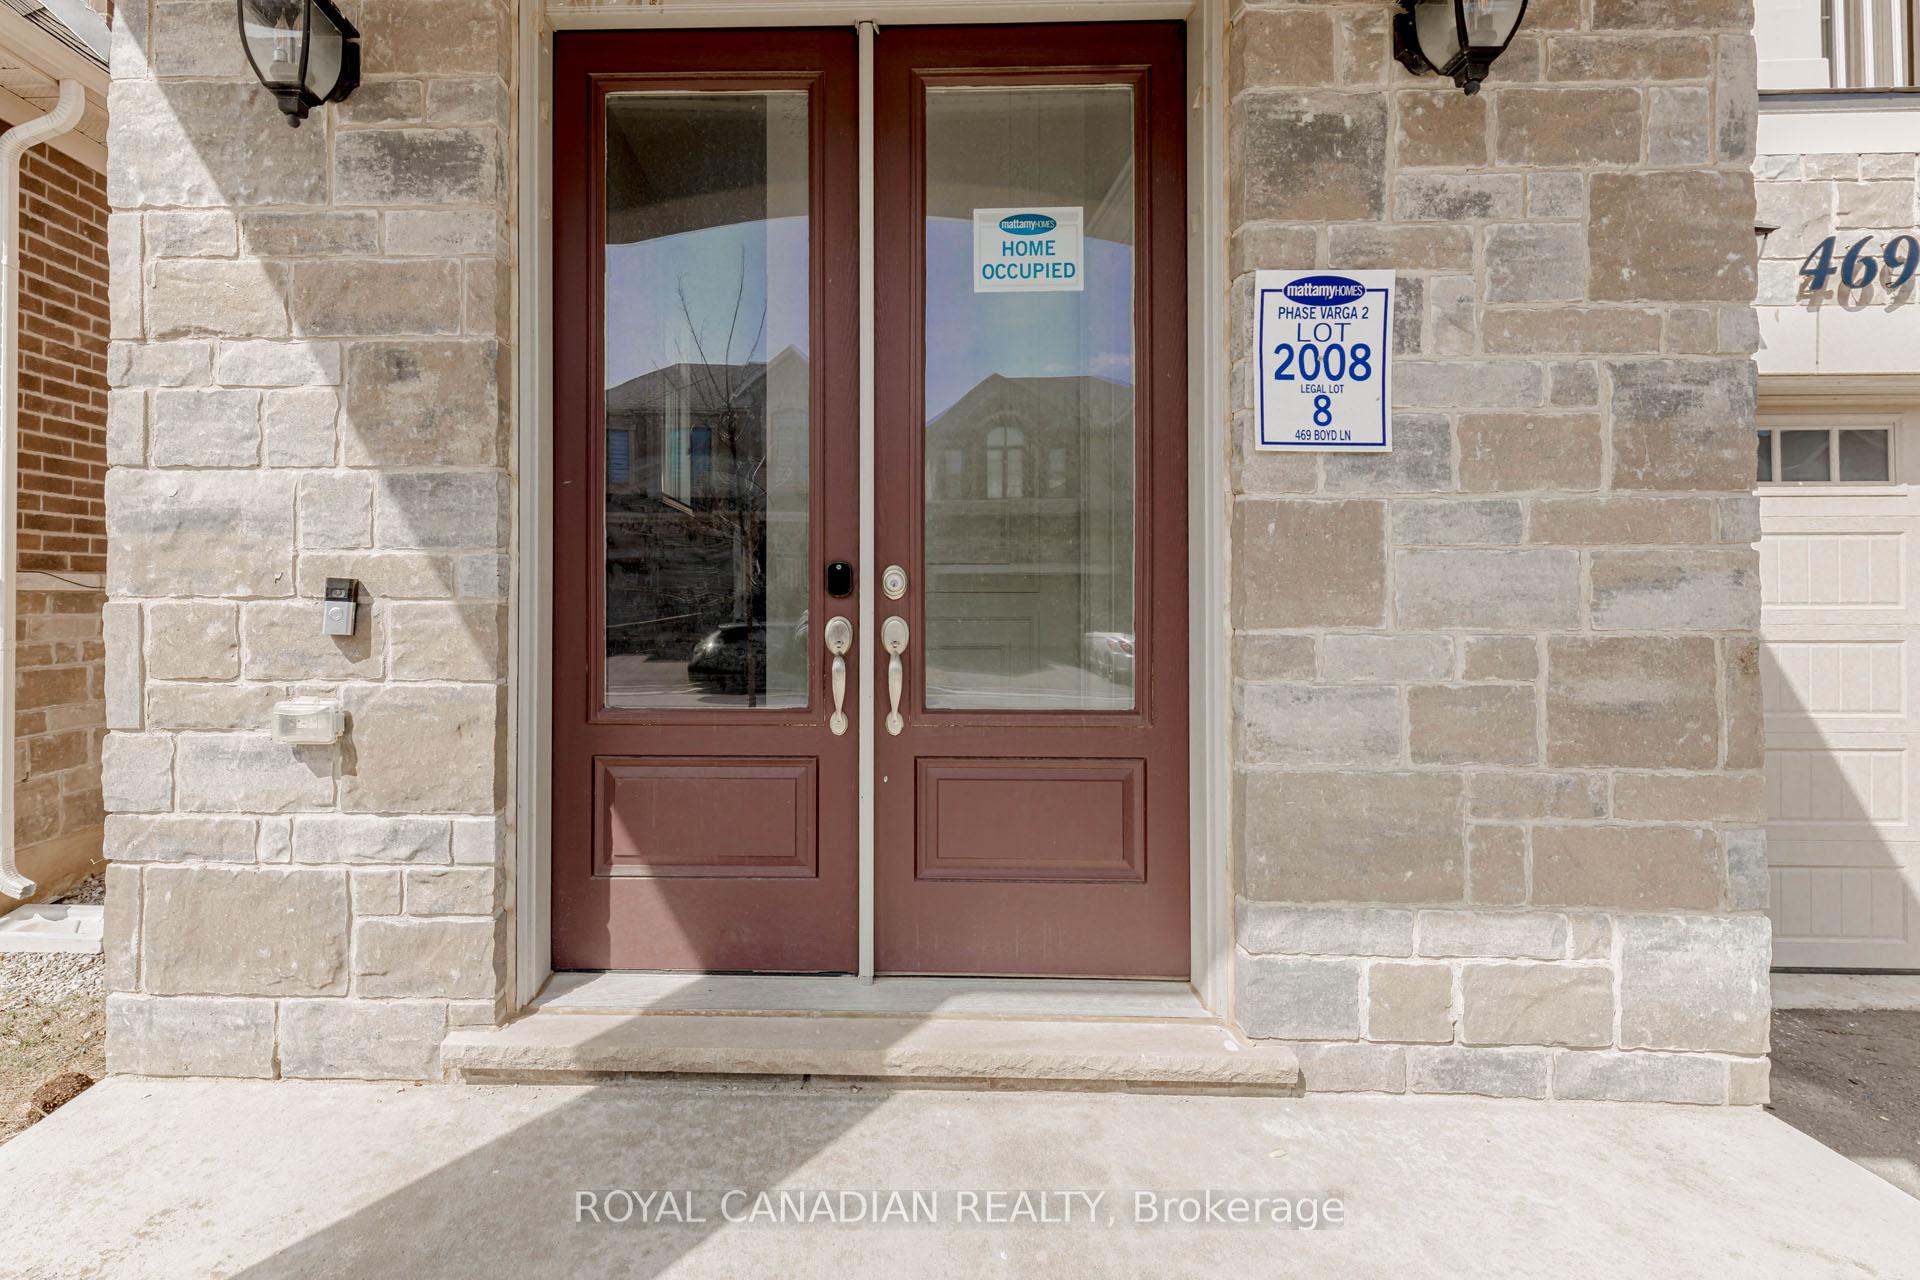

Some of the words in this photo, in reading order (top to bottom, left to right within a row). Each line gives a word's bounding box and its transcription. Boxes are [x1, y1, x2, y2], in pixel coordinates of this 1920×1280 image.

[1002, 240, 1056, 256] HOME
[982, 262, 1076, 280] OCCUPIED
[1799, 235, 1920, 290] 469
[1278, 307, 1316, 320] PHASE
[1320, 307, 1358, 320] VARGA
[1362, 307, 1369, 320] 2
[1297, 322, 1352, 342] LOT
[1273, 343, 1372, 381] 2008
[1300, 384, 1327, 394] LEGAL
[1329, 384, 1344, 394] LOT
[1313, 394, 1332, 427] 8
[1295, 430, 1311, 441] 469
[1314, 430, 1337, 441] BOYD
[1339, 430, 1351, 441] LN
